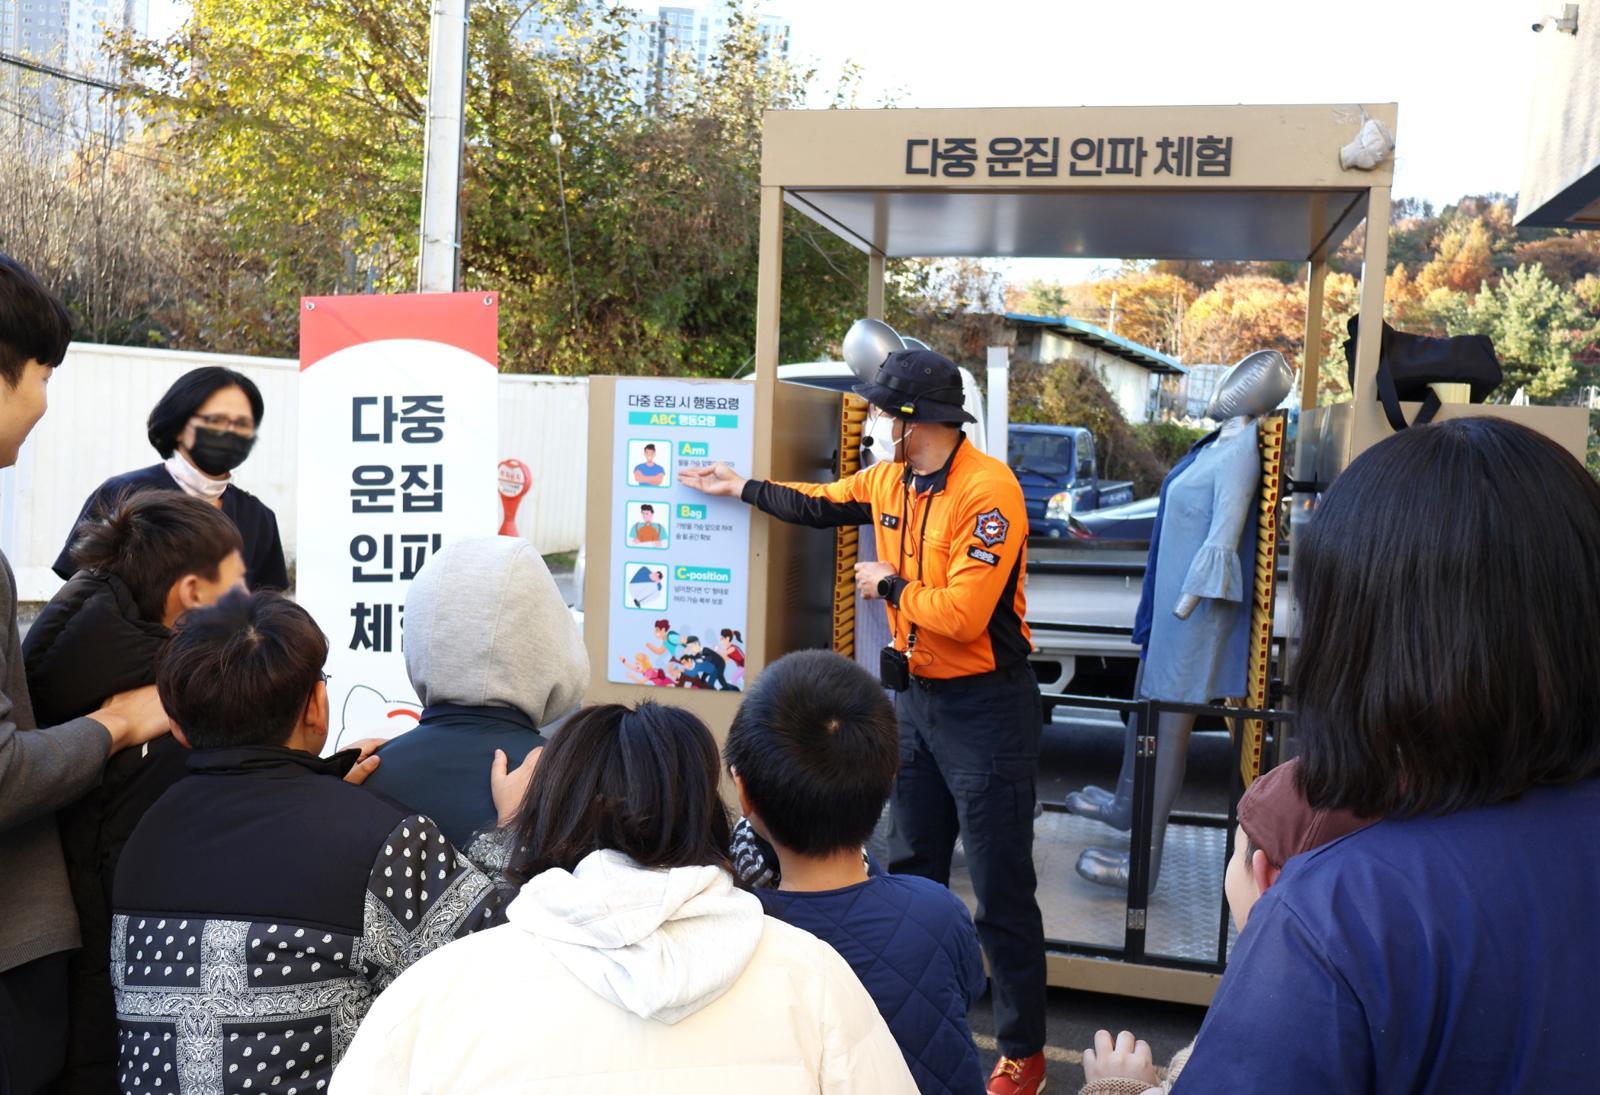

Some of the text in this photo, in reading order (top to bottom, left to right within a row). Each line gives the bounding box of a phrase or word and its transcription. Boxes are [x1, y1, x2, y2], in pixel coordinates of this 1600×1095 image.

[905, 135, 1234, 178] 다중 운집 인파 체험
[628, 394, 740, 411] 다중 운집 시 행동요령
[351, 394, 446, 445] 다중
[649, 414, 677, 425] ABC
[681, 443, 706, 456] Arm
[349, 463, 444, 514] 운집
[680, 505, 703, 519] Bag
[676, 567, 729, 582] C-position
[348, 601, 405, 653] 체
